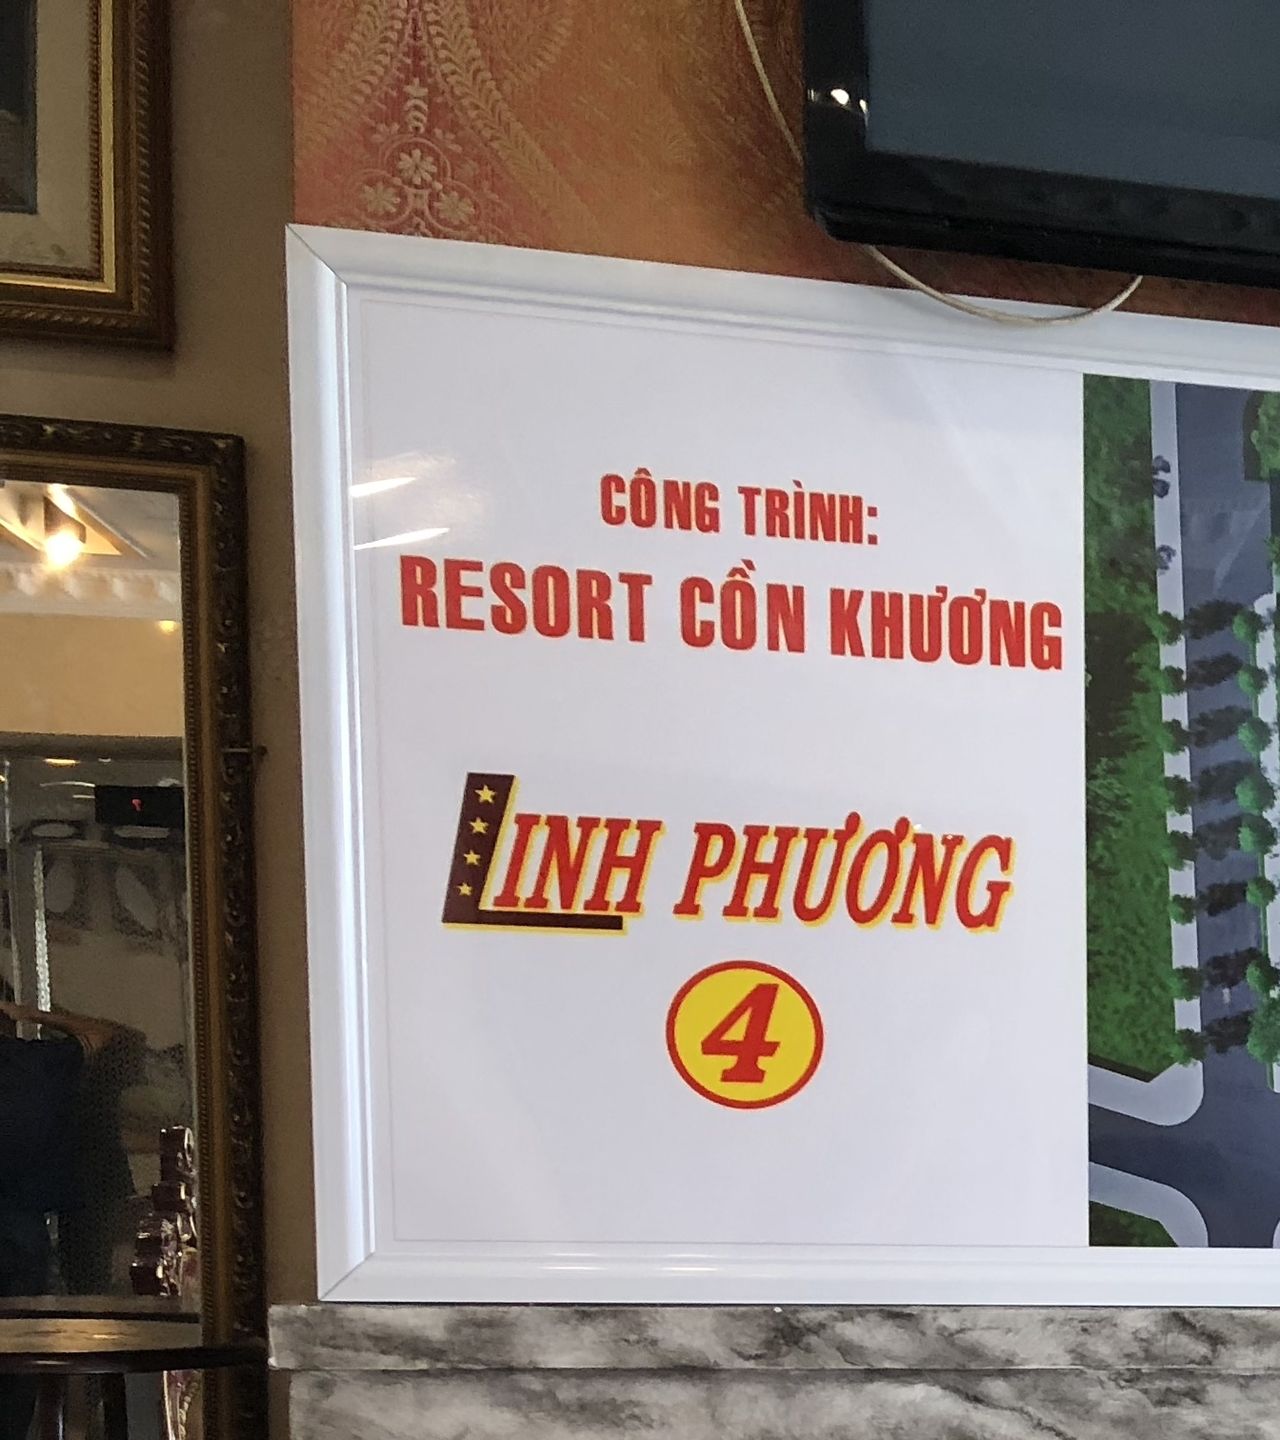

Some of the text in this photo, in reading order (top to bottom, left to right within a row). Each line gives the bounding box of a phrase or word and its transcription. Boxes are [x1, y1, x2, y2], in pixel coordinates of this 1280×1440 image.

[600, 467, 878, 546] CÔNG TRÌNH:
[400, 555, 1063, 671] RESORT CỒN KHƯƠNG
[442, 772, 1015, 934] LINH PHƯƠNG
[700, 982, 782, 1083] 4
